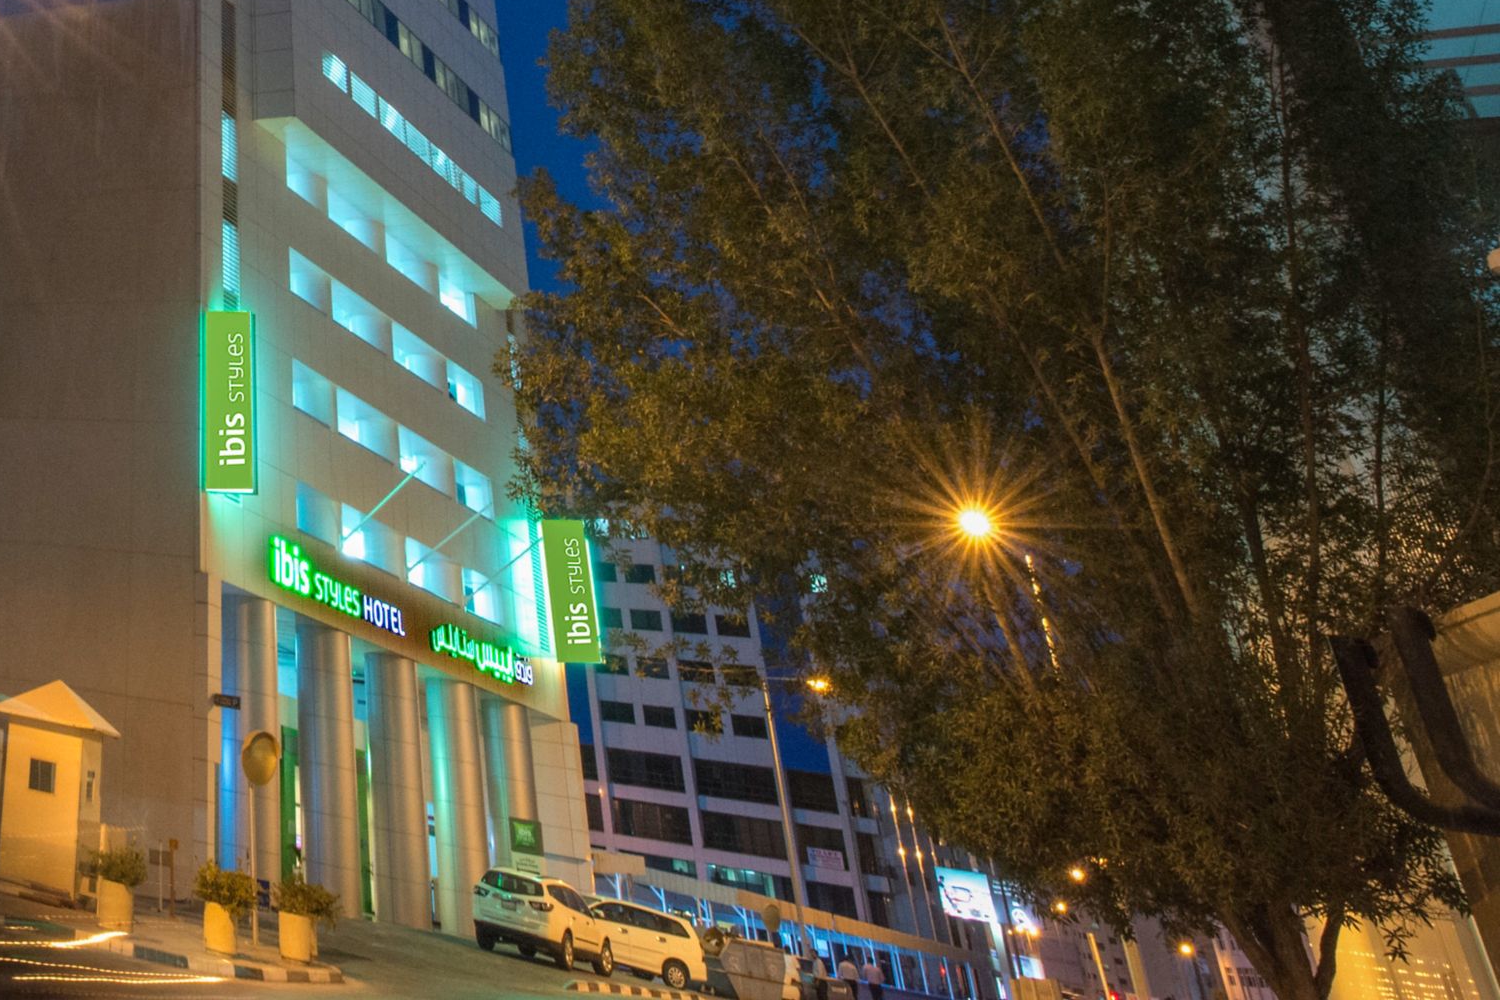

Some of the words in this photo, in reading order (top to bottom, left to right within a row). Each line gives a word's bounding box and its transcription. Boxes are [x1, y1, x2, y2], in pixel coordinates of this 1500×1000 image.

[219, 413, 245, 465] ibis
[273, 536, 310, 594] ibis
[363, 594, 406, 637] HOTEL
[564, 602, 592, 644] ibis
